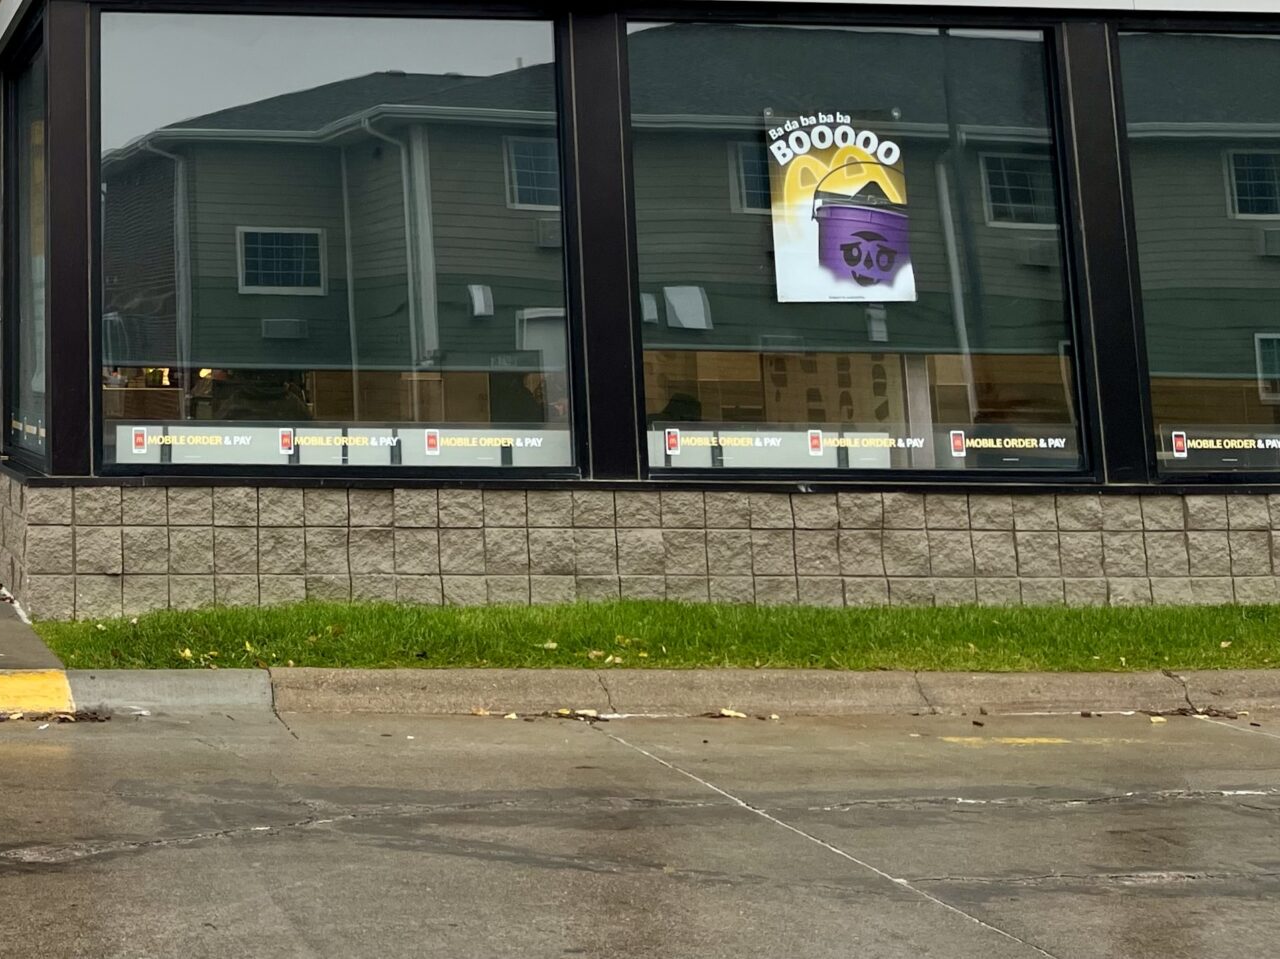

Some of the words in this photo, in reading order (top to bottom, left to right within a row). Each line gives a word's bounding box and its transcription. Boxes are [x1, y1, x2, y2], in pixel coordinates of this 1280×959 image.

[768, 127, 785, 140] Ba
[784, 120, 799, 132] da
[800, 115, 817, 127] ba
[818, 112, 834, 124] ba
[836, 112, 851, 124] ba
[769, 125, 901, 166] BOOOOO
[147, 436, 185, 446] MOBILE
[187, 436, 222, 446] ORDER
[223, 436, 232, 446] &
[233, 436, 252, 446] PAY
[294, 436, 333, 447] MOBILE
[334, 436, 369, 447] ORDER
[370, 436, 379, 447] &
[380, 436, 399, 447] PAY
[440, 437, 478, 447] MOBILE
[479, 437, 515, 447] ORDER
[515, 437, 524, 447] &
[525, 437, 543, 447] PAY
[680, 437, 718, 447] MOBILE
[718, 437, 753, 447] ORDER
[754, 437, 763, 447] &
[764, 437, 782, 447] PAY
[823, 437, 860, 448] MOBILE
[861, 437, 896, 448] ORDER
[897, 437, 905, 448] &
[906, 437, 925, 448] PAY
[965, 438, 1003, 449] MOBILE
[1004, 438, 1038, 449] ORDER
[1038, 438, 1047, 449] &
[1047, 438, 1066, 449] PAY
[1186, 439, 1223, 449] MOBILE
[1223, 439, 1256, 449] ORDER
[1256, 439, 1265, 449] &
